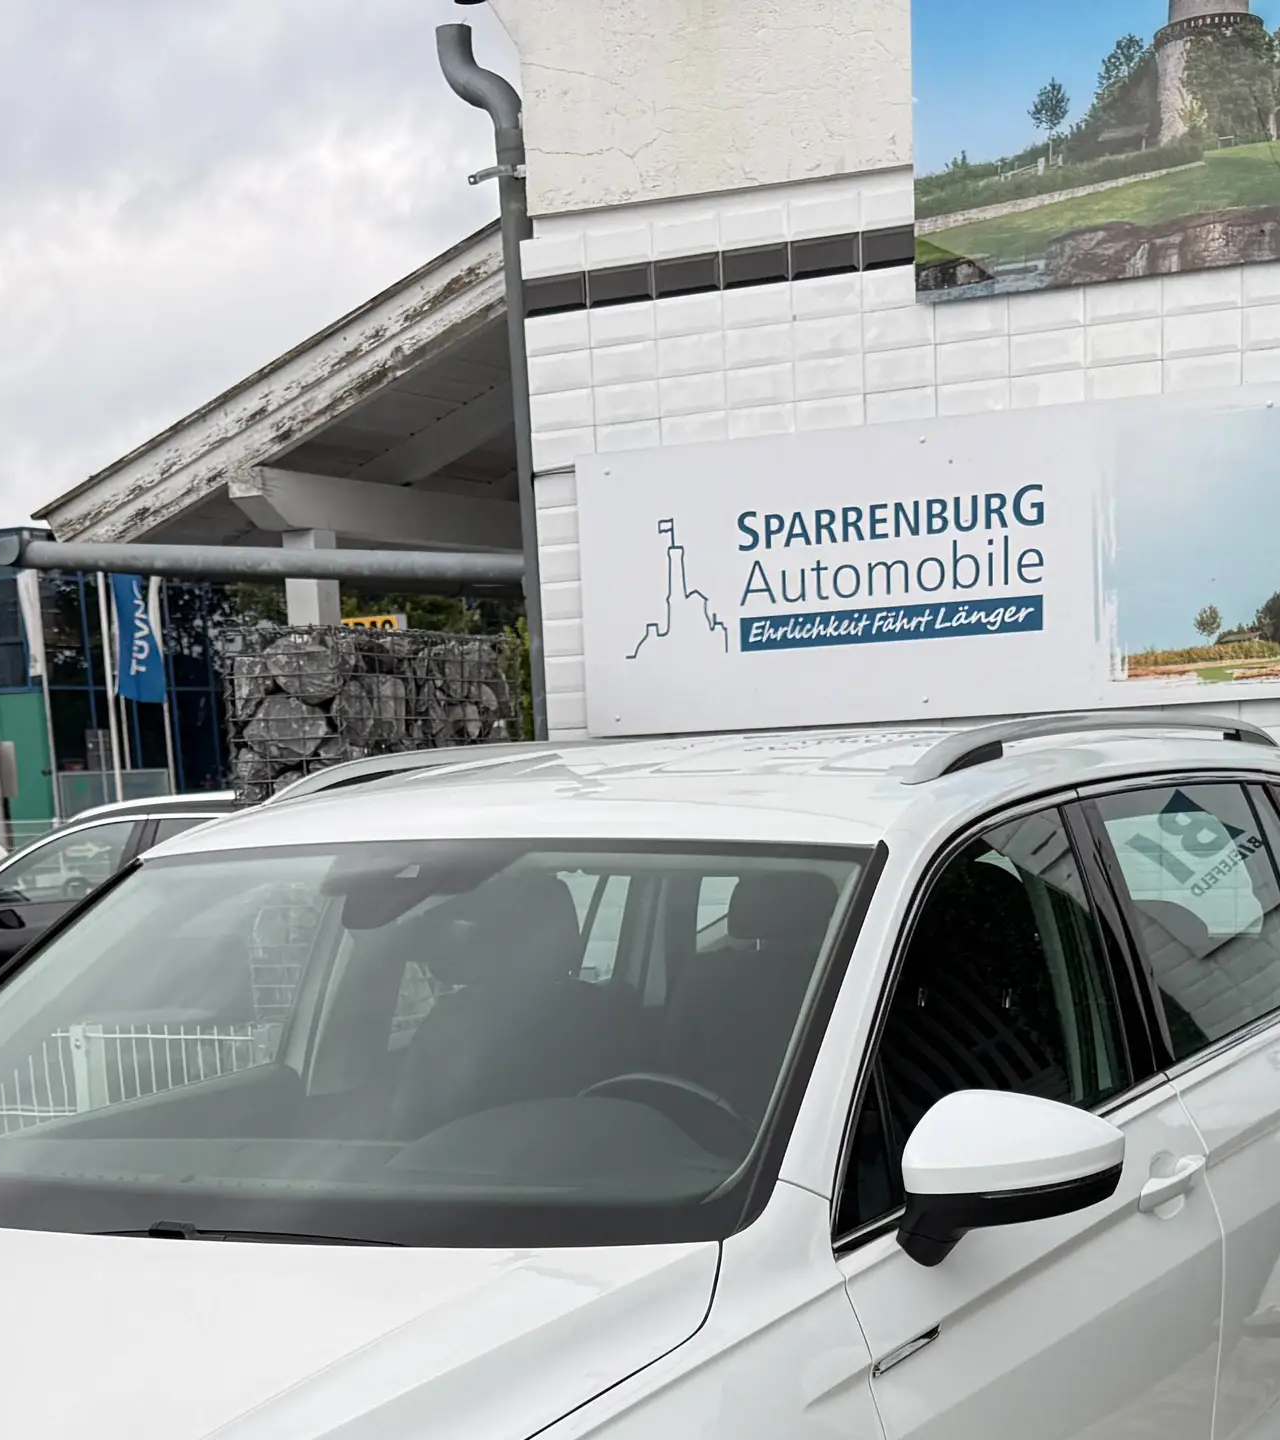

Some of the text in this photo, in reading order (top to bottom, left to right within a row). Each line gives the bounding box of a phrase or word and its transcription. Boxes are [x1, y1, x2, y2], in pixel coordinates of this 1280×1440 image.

[736, 484, 1044, 552] SPARRENBURG
[740, 536, 1044, 607] Automobile
[748, 601, 1035, 644] Ehrlichkeit Fährt Länger
